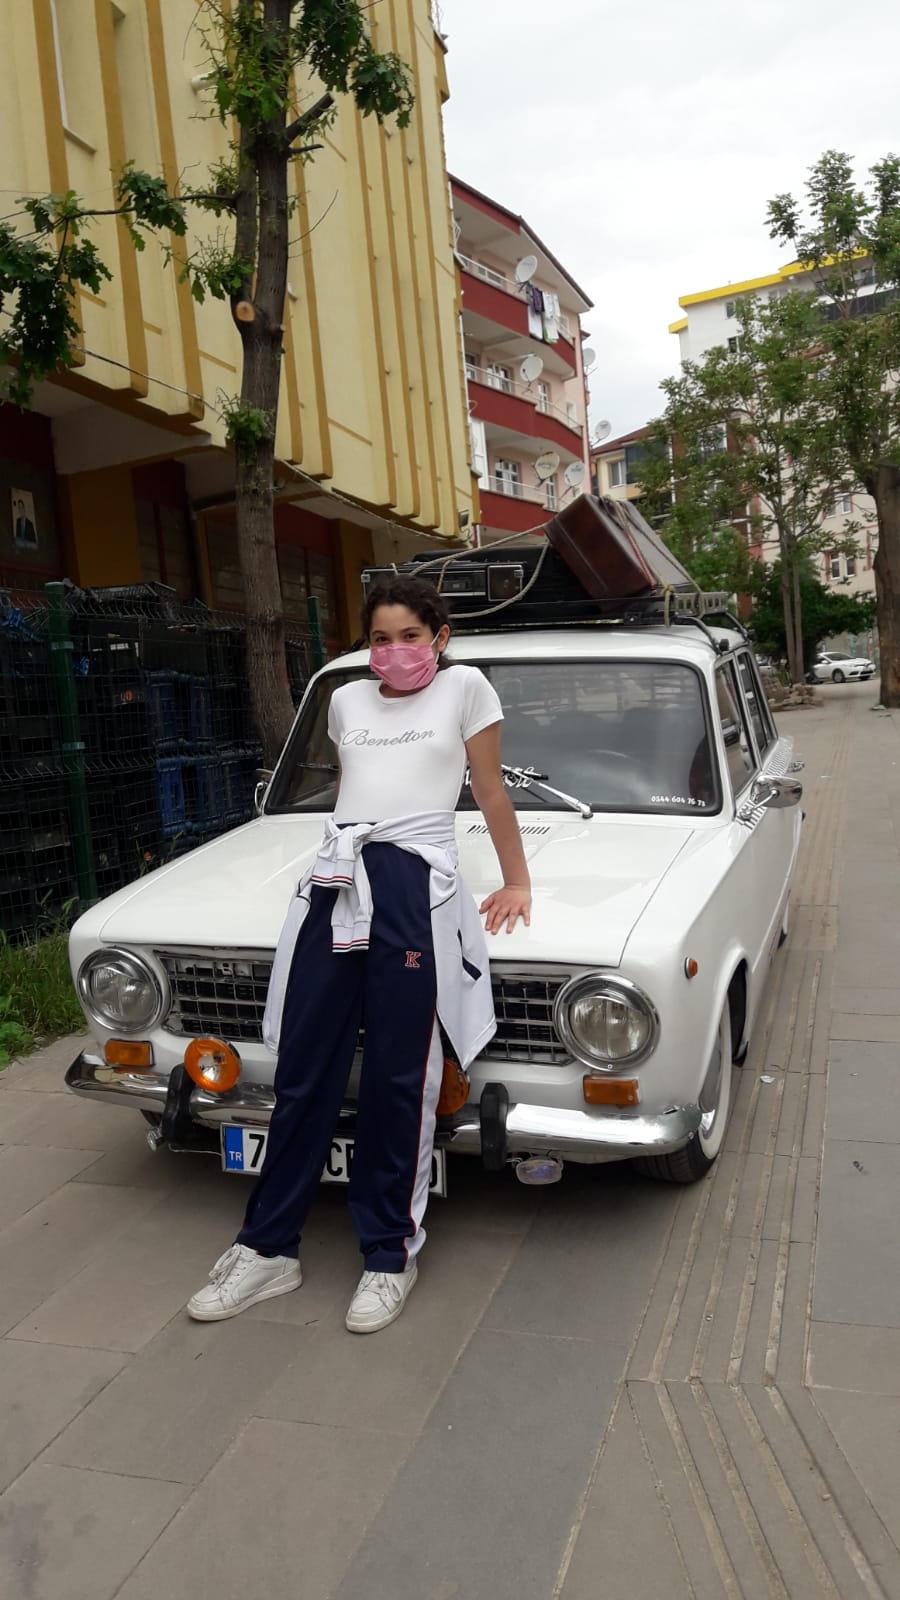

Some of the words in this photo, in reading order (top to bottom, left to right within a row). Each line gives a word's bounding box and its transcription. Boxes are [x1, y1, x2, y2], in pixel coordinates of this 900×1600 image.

[342, 728, 435, 746] Benetton
[404, 950, 422, 969] K
[229, 1150, 242, 1161] TR
